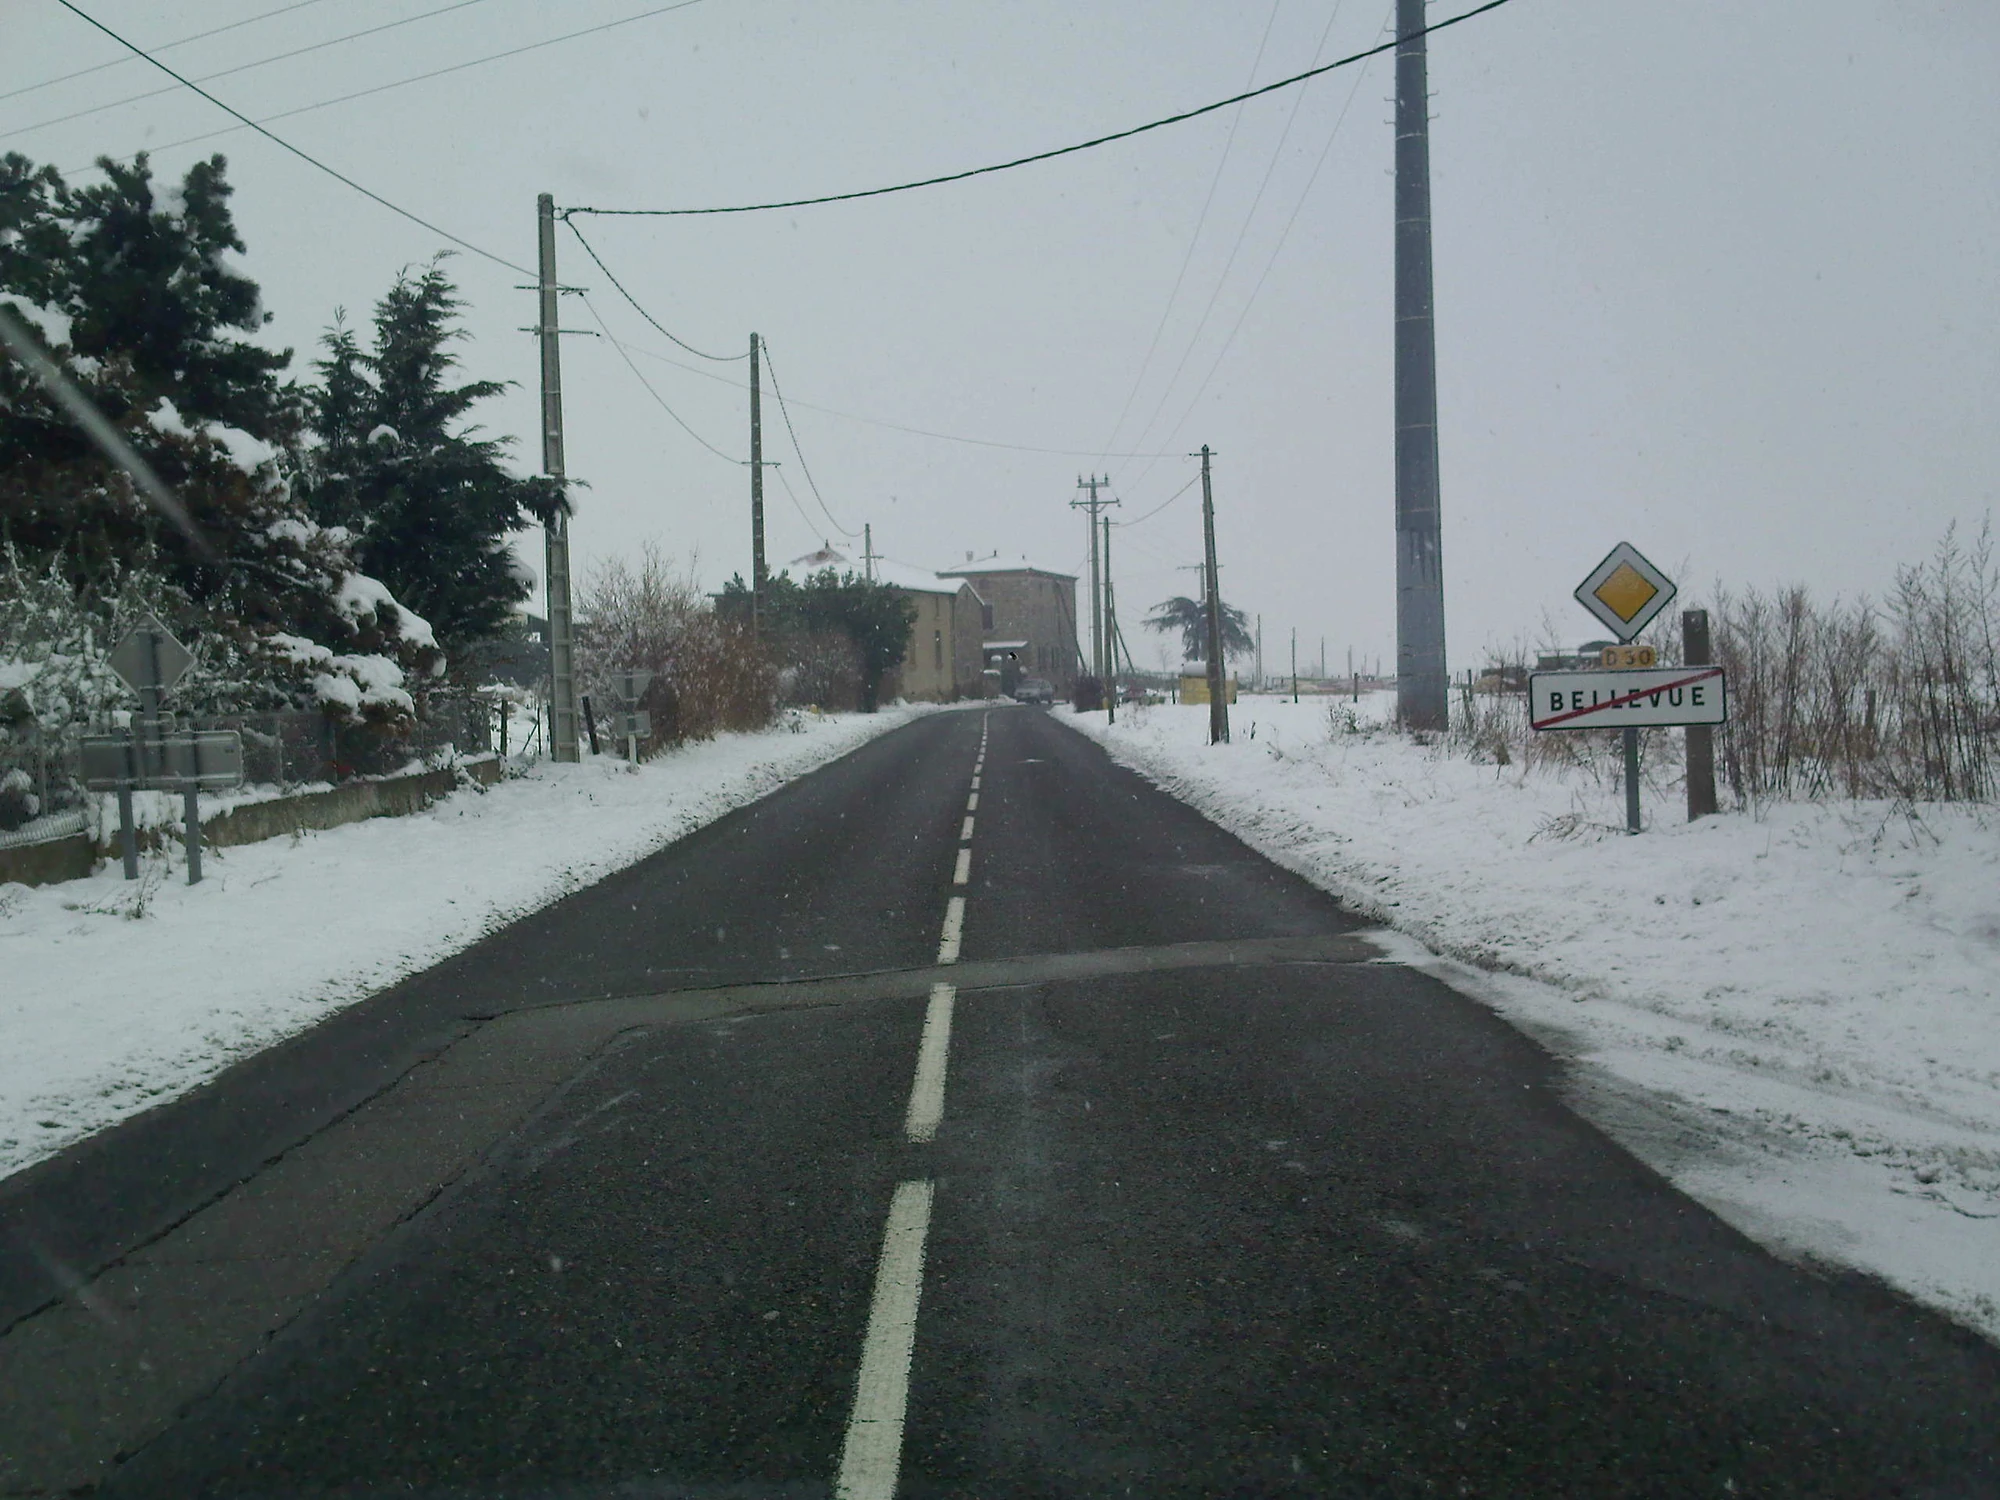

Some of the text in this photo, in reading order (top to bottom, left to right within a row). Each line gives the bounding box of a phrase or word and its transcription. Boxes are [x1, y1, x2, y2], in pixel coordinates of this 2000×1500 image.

[1606, 649, 1651, 666] D 30
[1550, 687, 1705, 711] BELLEVUE
